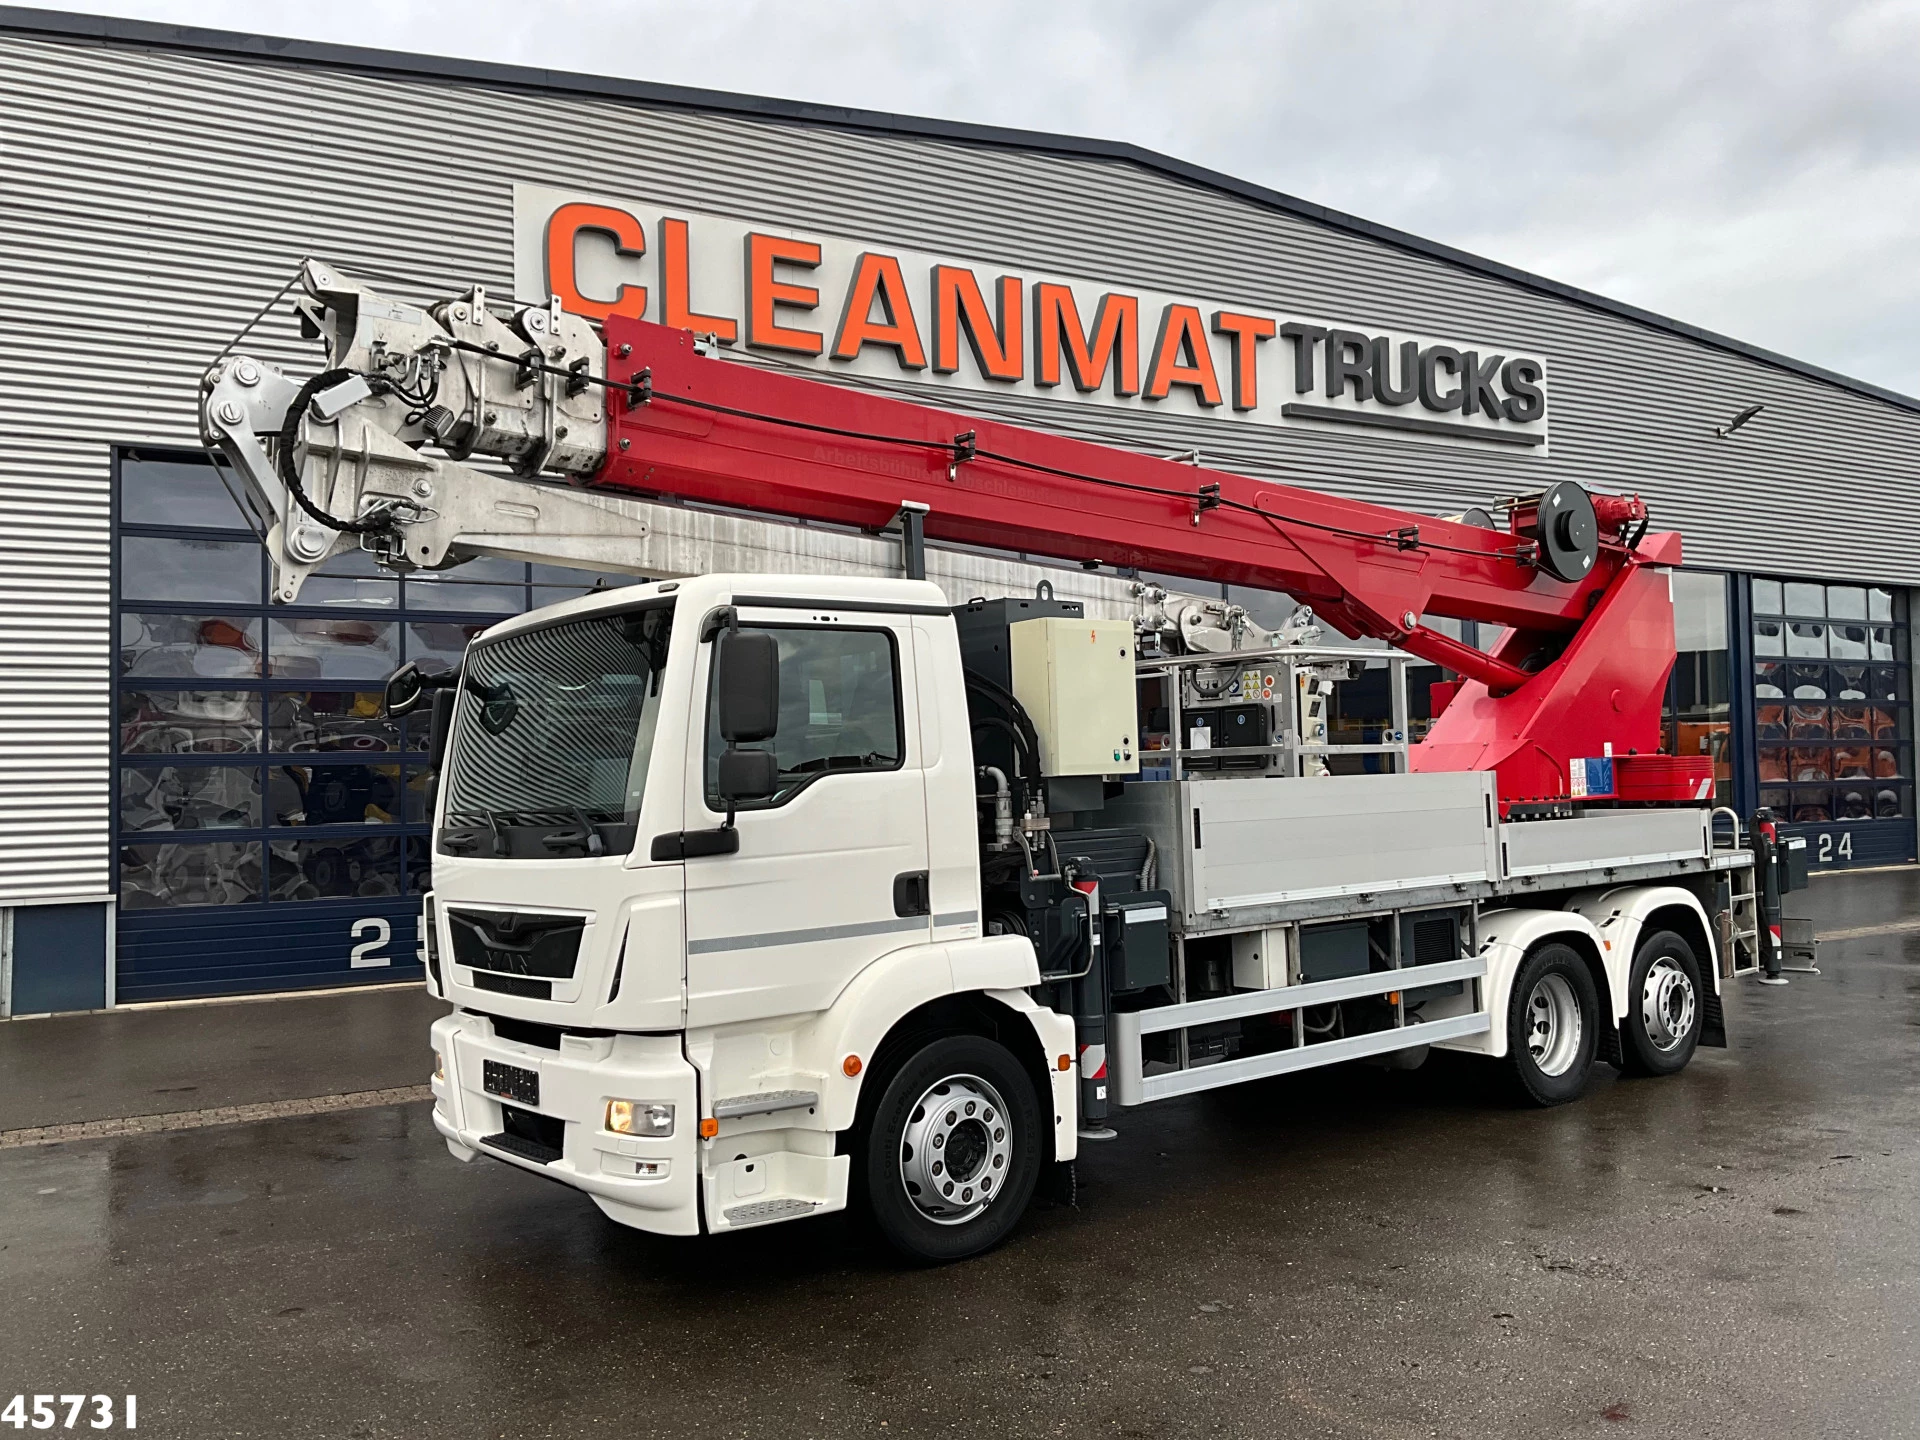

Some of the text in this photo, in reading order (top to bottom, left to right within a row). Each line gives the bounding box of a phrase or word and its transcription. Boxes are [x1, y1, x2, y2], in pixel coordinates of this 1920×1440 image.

[543, 201, 1545, 423] CLEANMAT TRUCKS
[1818, 832, 1853, 862] 24
